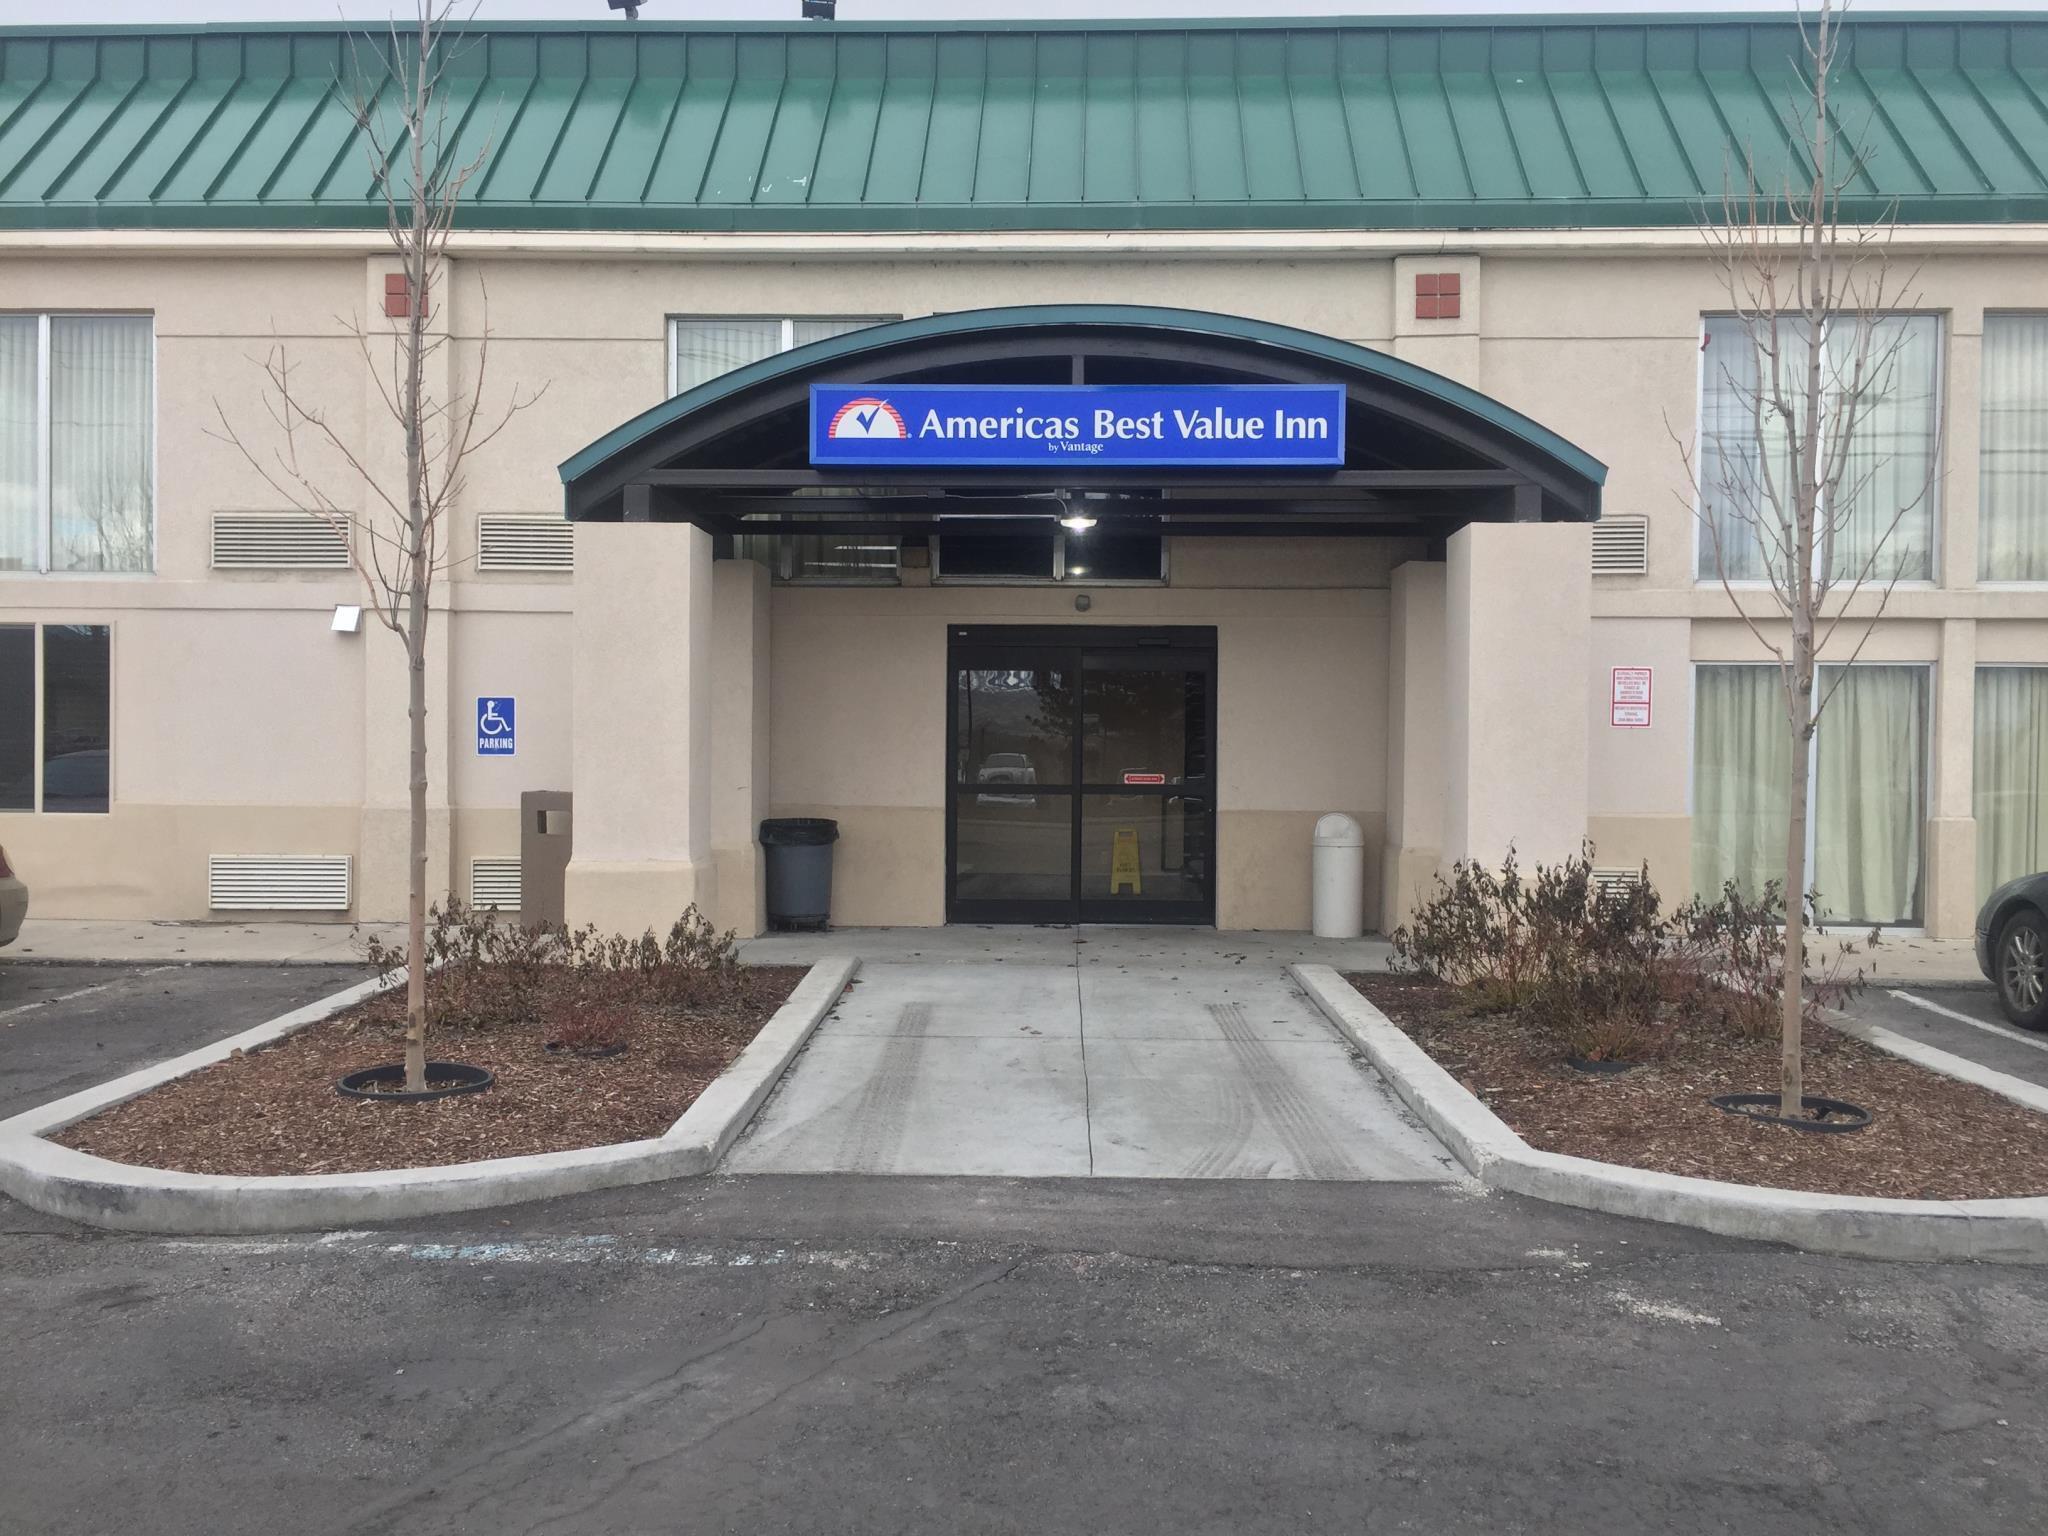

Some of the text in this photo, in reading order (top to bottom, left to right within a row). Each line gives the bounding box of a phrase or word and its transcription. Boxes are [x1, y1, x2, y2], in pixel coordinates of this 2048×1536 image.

[918, 407, 1328, 440] Americas Best Value Inn
[1048, 441, 1104, 455] by Vantage
[479, 738, 513, 749] PARKING
